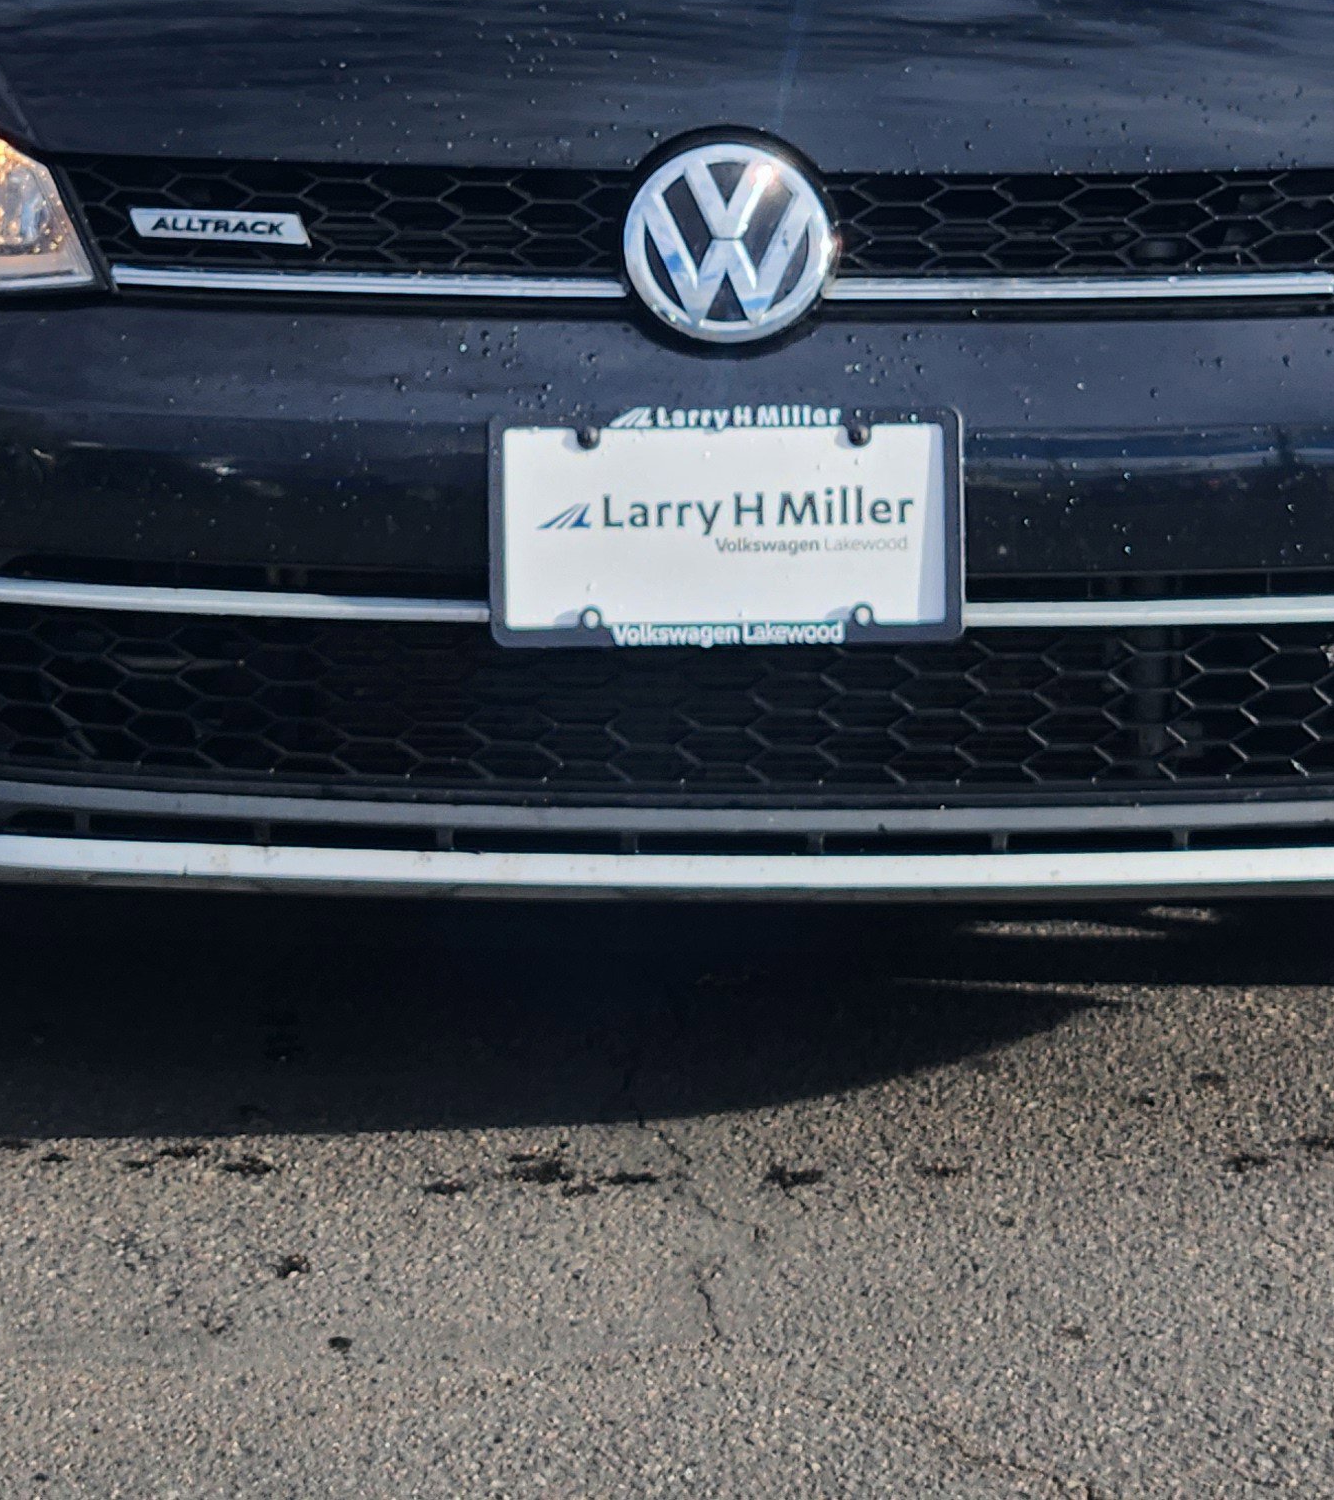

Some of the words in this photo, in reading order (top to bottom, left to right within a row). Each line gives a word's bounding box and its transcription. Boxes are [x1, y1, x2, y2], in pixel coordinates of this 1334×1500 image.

[151, 217, 284, 235] ALLTRACK
[657, 405, 730, 432] Larry
[733, 404, 754, 428] H
[756, 404, 842, 428] Miller
[602, 493, 722, 535] Larry
[734, 491, 765, 526] H
[777, 485, 914, 526] Miller
[716, 537, 819, 555] Volkswagen
[823, 536, 908, 552] Lakewood
[612, 622, 741, 648] Volkswagen
[741, 620, 846, 645] Lakewood
